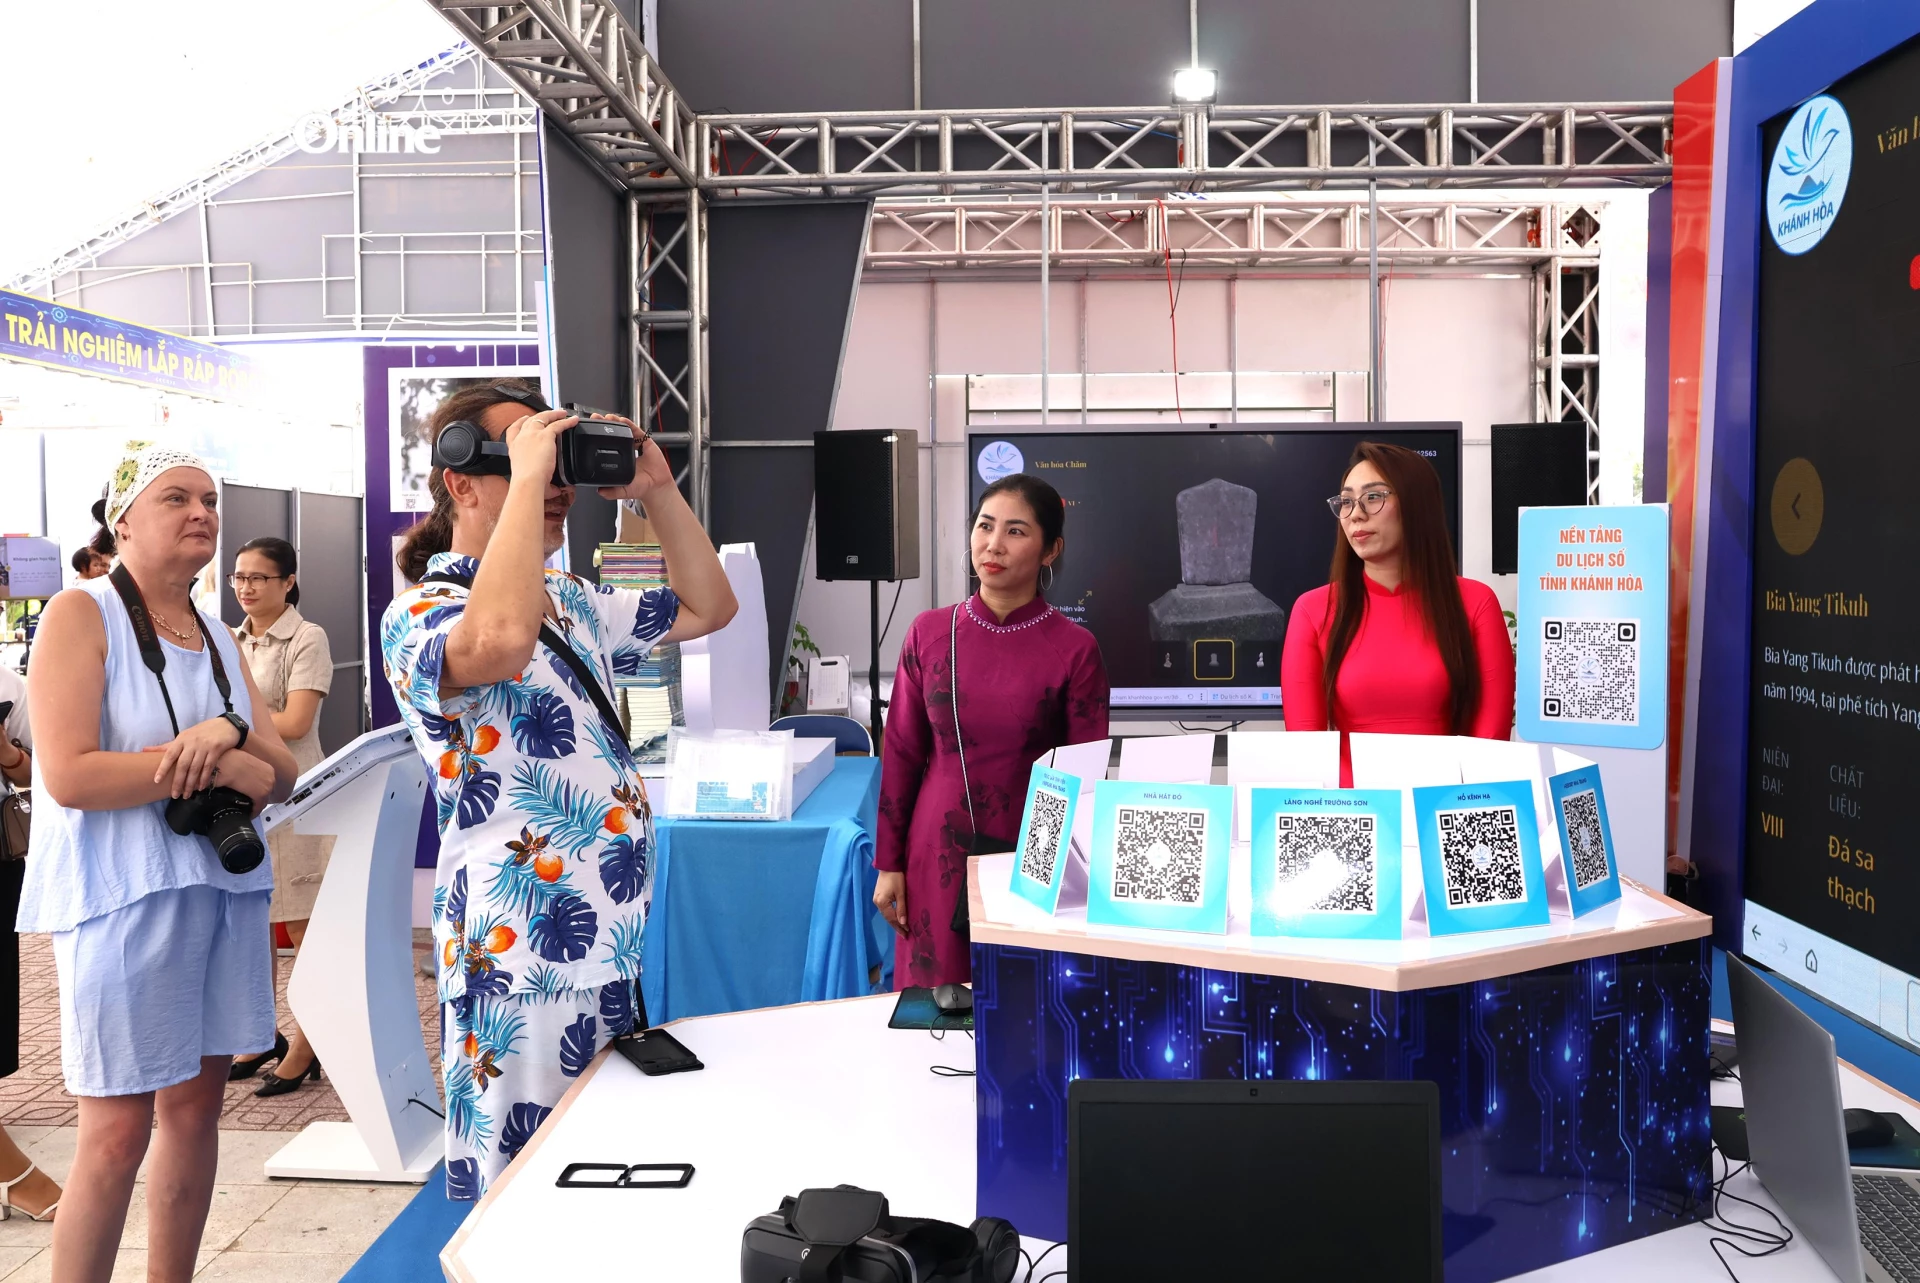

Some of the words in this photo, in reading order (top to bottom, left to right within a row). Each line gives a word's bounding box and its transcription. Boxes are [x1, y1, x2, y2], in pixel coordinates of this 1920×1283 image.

[1877, 125, 1908, 153] Văn
[1777, 211, 1810, 237] KHÁNH
[1812, 200, 1834, 221] HÒA
[5, 311, 56, 351] TRẢI
[62, 328, 142, 373] NGHIỆM
[148, 338, 180, 378] LẮP
[183, 352, 215, 385] RÁP
[1035, 461, 1049, 469] Văn
[1050, 460, 1064, 469] hóa
[1589, 524, 1622, 543] TẢNG
[1556, 553, 1573, 567] DU
[1577, 553, 1604, 570] LỊCH
[1608, 548, 1625, 567] SỐ
[1539, 572, 1567, 591] TỈNH
[1571, 574, 1613, 591] KHÁNH
[1617, 573, 1643, 591] HÒA
[1766, 589, 1786, 612] Bia
[1788, 591, 1821, 618] Yang
[1824, 592, 1868, 617] Tikuh
[131, 605, 150, 641] Canon
[1764, 646, 1780, 664] Bia
[1782, 649, 1808, 673] Yang
[1811, 652, 1842, 673] Tikuh
[1845, 656, 1876, 680] được
[1880, 660, 1911, 684] phát
[1764, 682, 1786, 700] năm
[1789, 685, 1818, 709] 1994,
[1821, 691, 1836, 712] tại
[1838, 693, 1862, 716] phế
[1865, 697, 1888, 719] tích
[1762, 745, 1789, 769] NIÊN
[1762, 775, 1784, 797] ĐẠI:
[1829, 763, 1864, 789] CHẤT
[1143, 791, 1157, 799] NHÀ
[1158, 792, 1171, 800] HÁT
[1324, 798, 1352, 806] TRƯỜNG
[1829, 793, 1861, 820] LIỆU:
[1761, 811, 1784, 839] VIII
[1828, 834, 1850, 863] Đá
[1855, 849, 1875, 872] sa
[1827, 876, 1876, 915] thạch
